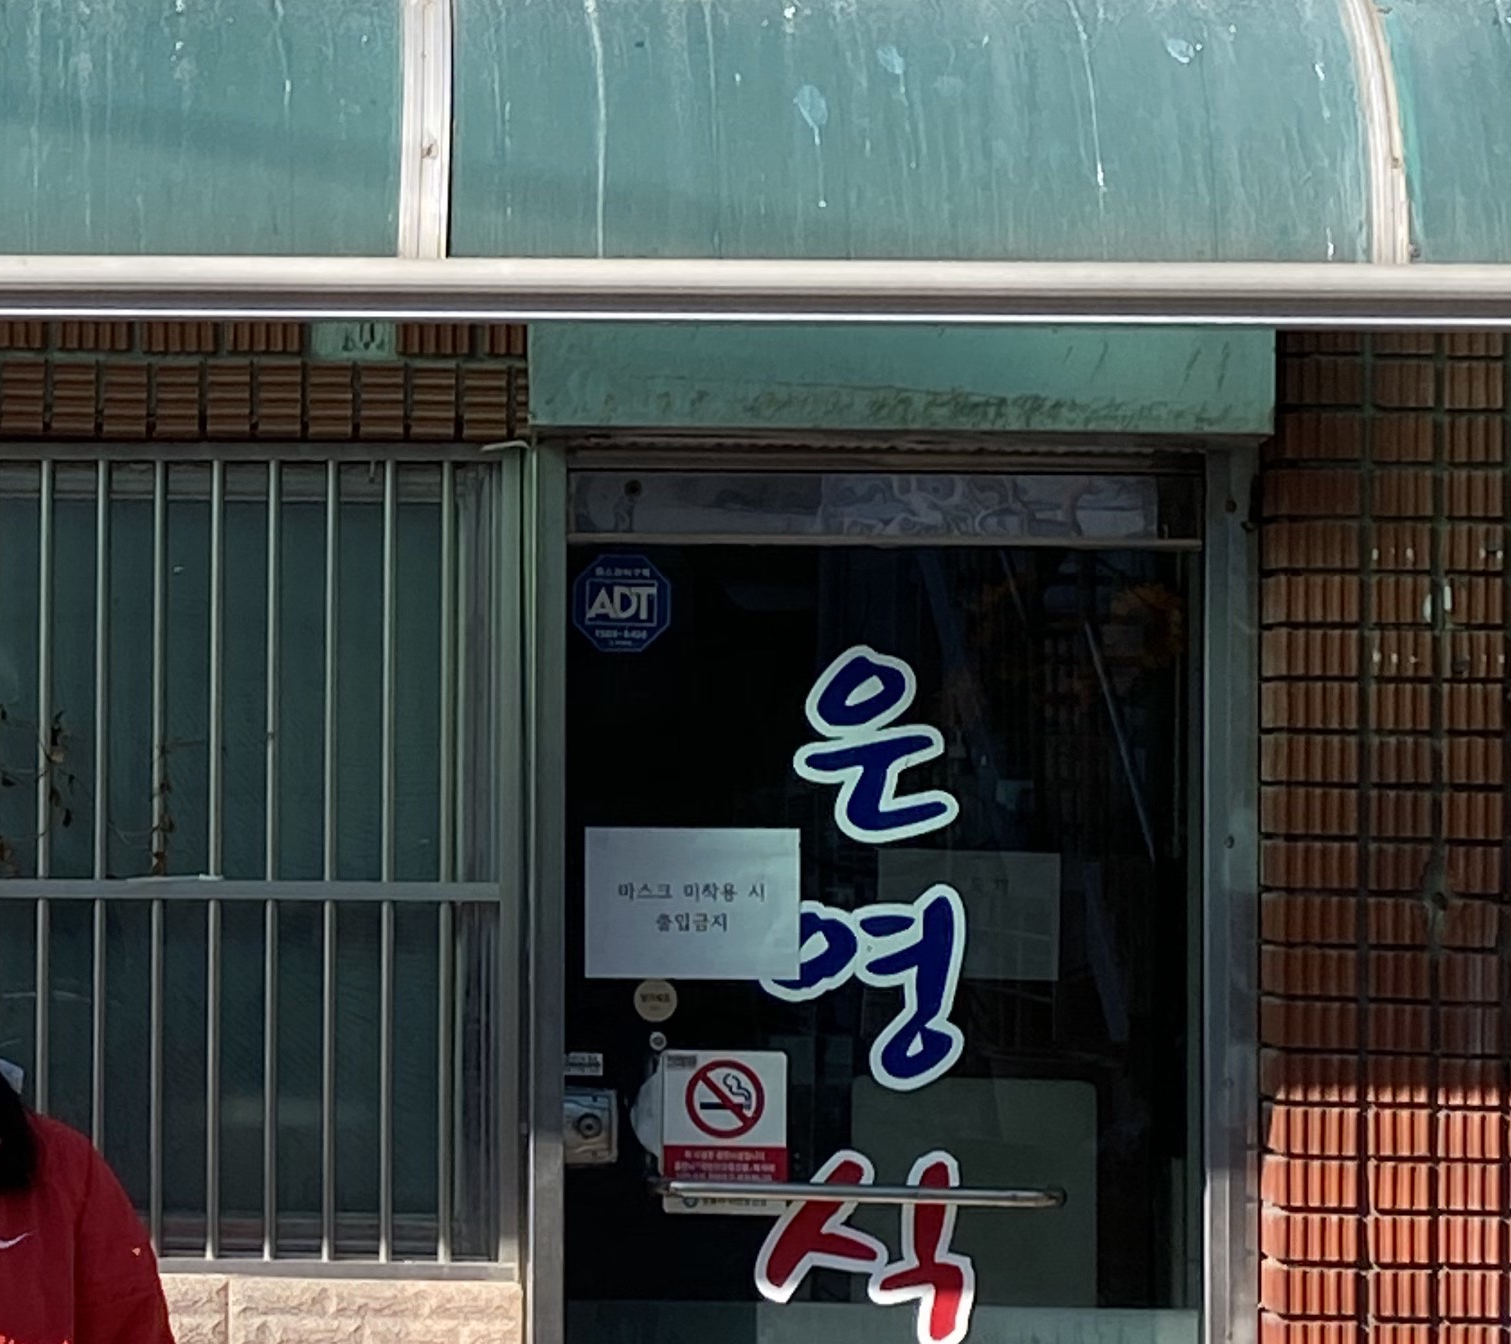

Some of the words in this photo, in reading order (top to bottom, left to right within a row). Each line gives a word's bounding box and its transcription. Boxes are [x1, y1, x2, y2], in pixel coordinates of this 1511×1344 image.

[586, 585, 657, 620] ADT
[618, 882, 673, 903] 마스크
[683, 882, 737, 903] 미착용
[748, 883, 766, 902] 시
[655, 912, 728, 933] 출입금지
